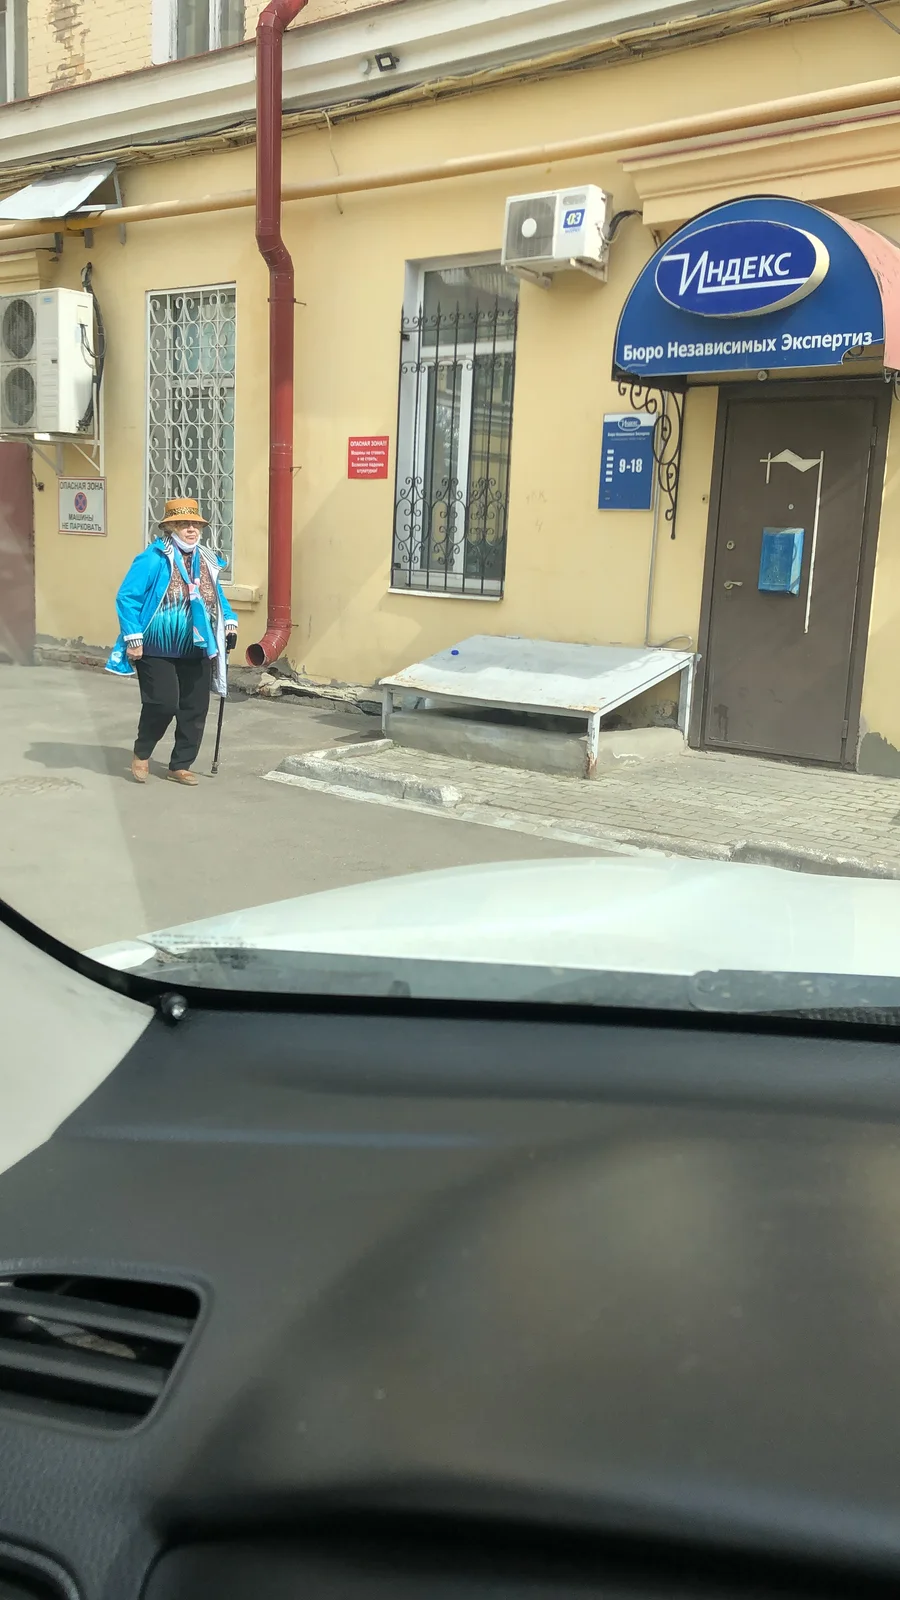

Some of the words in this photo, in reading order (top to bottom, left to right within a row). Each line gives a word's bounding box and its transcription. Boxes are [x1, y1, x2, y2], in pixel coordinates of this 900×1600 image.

[664, 250, 800, 296] ИНДЕКС
[623, 344, 664, 363] Бюро
[667, 338, 777, 359] Независимых
[781, 331, 873, 351] Экспертиз
[619, 458, 643, 473] 9-18
[60, 481, 86, 490] ОПАСНАЯ
[87, 482, 103, 490] ЗОНА
[69, 522, 102, 531] ПАРКОВАТЬ
